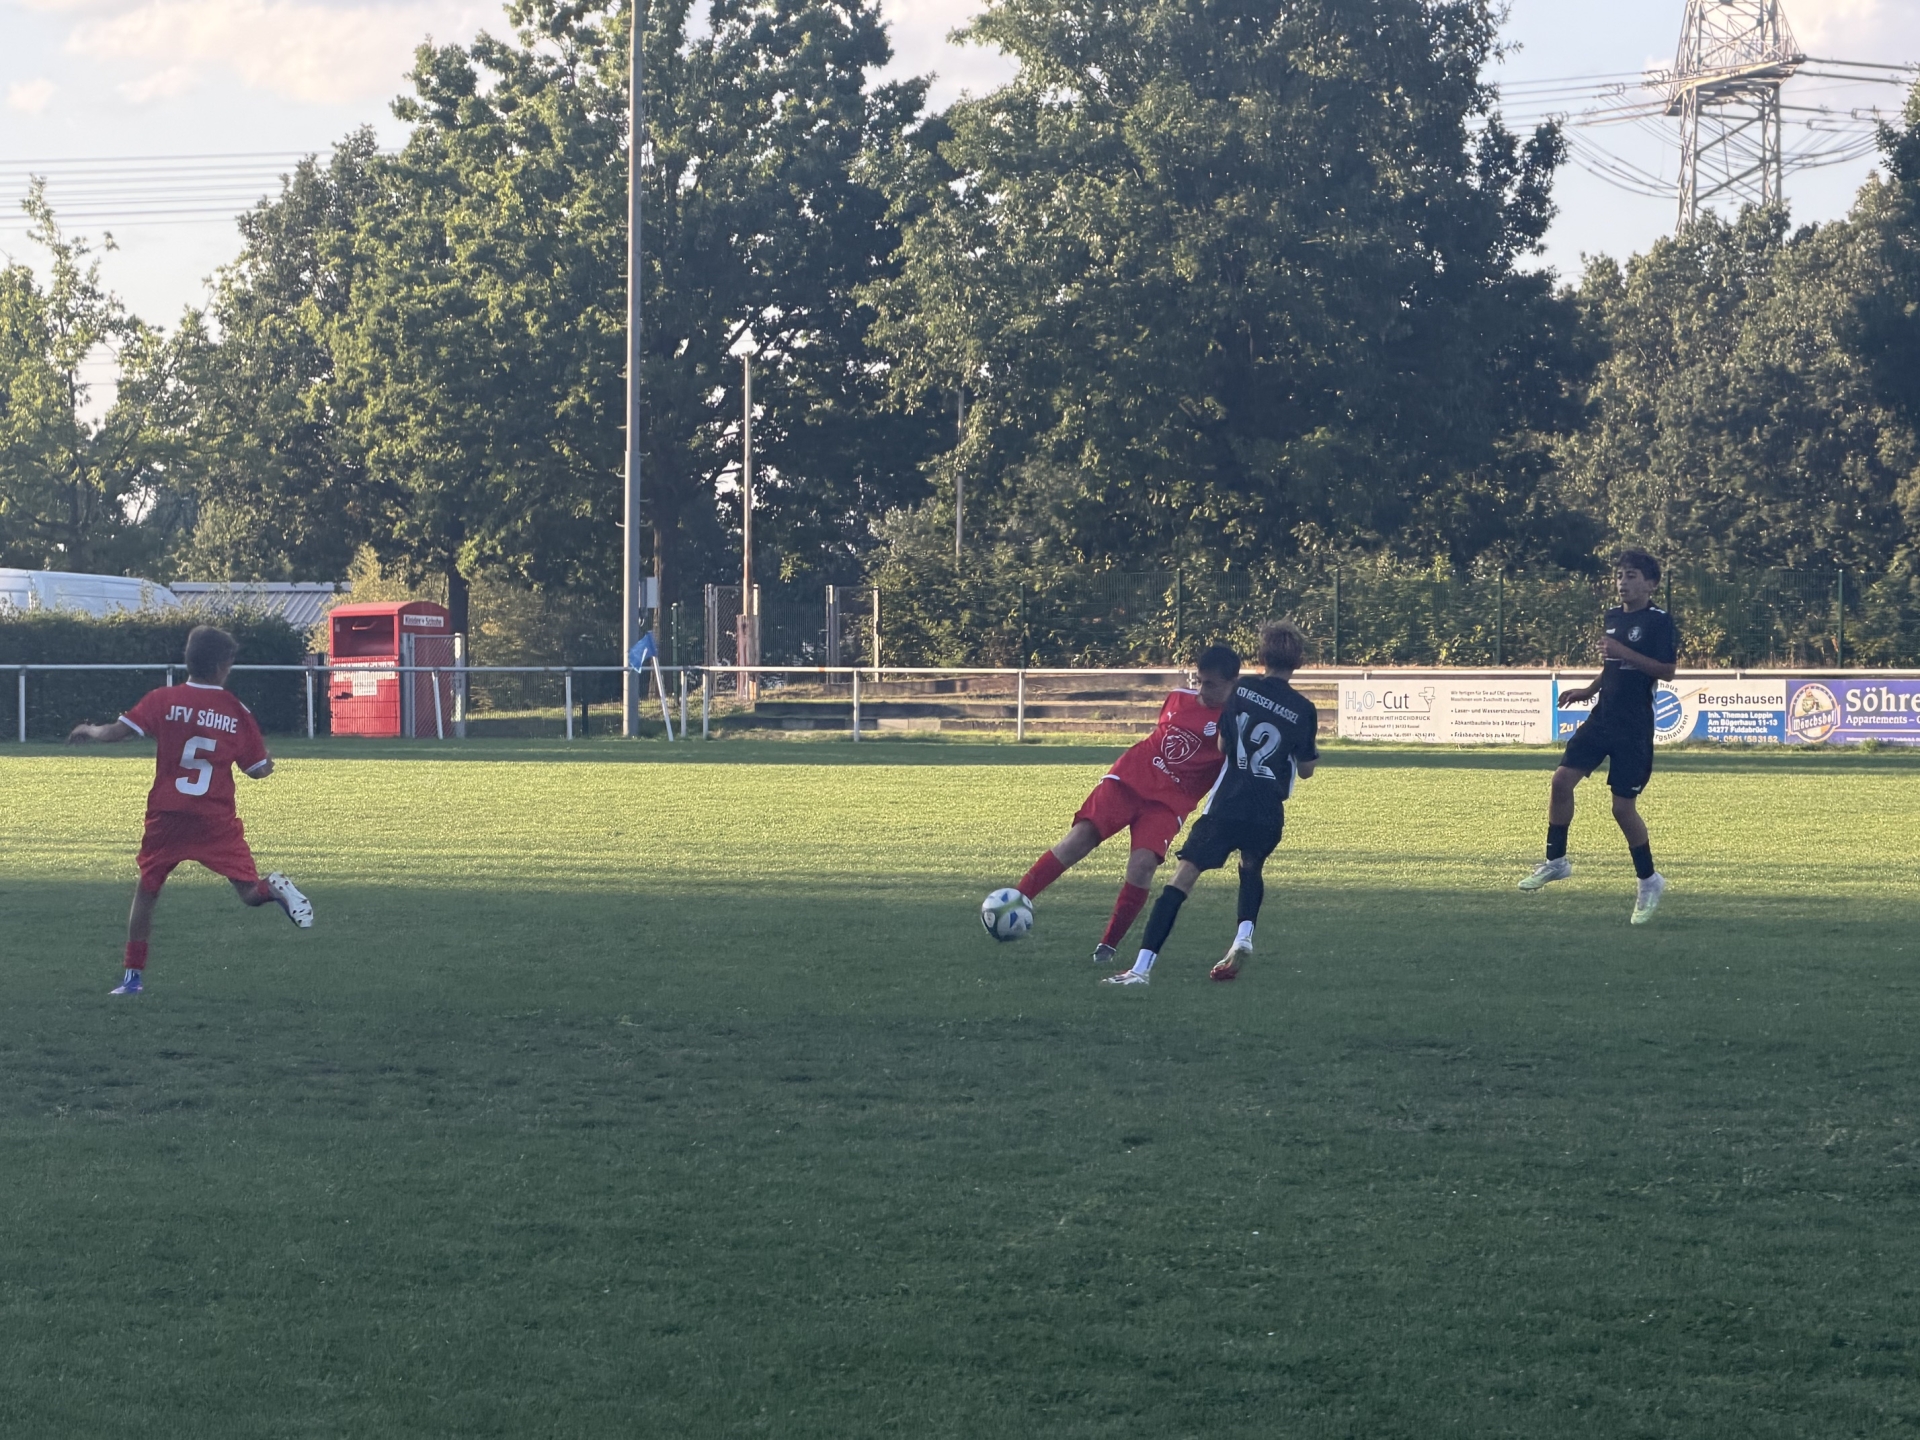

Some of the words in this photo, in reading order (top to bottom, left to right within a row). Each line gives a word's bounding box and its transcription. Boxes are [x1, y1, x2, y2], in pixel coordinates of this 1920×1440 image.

[1246, 689, 1275, 711] HESSEN
[1272, 703, 1299, 724] KASSEL
[1698, 692, 1783, 707] Bergshausen
[165, 705, 193, 723] JFV
[196, 708, 238, 734] SÖHRE
[1559, 722, 1574, 734] Zu
[1845, 714, 1908, 727] Appartements
[1235, 711, 1282, 780] 12
[175, 735, 217, 796] 5
